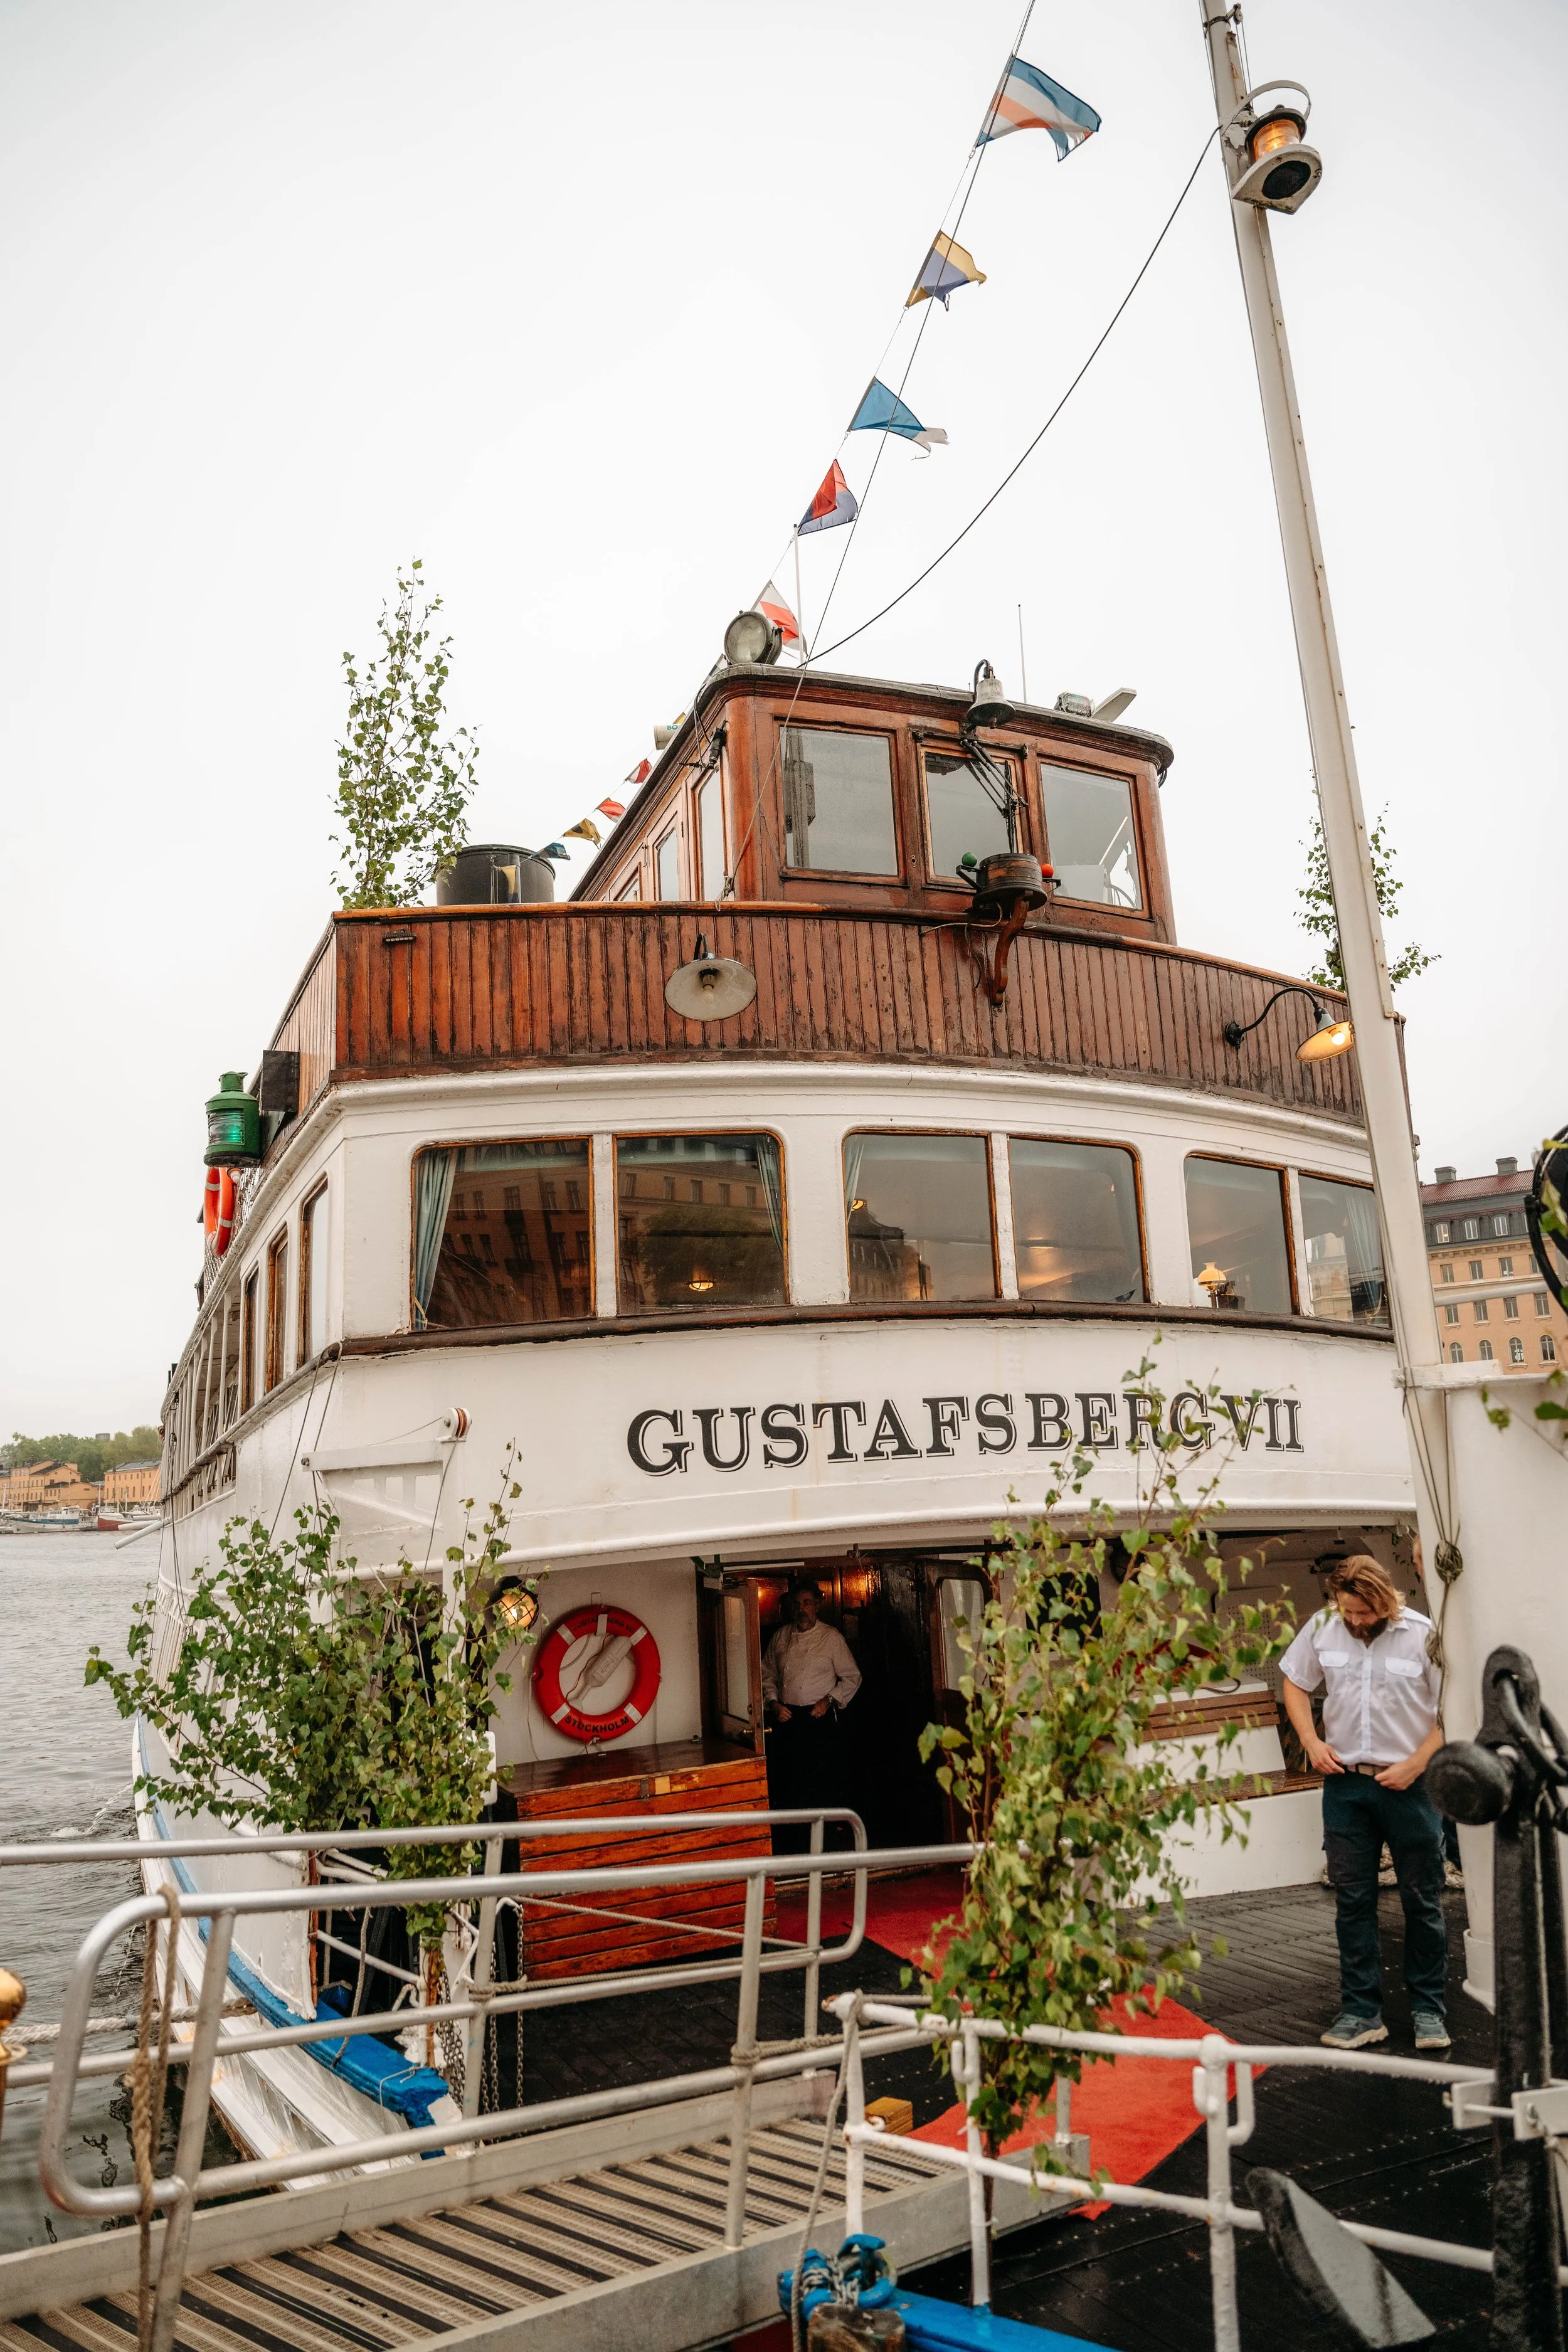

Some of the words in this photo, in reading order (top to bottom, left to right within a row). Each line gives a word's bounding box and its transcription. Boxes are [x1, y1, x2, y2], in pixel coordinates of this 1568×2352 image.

[627, 1392, 1216, 1476] GUSTAFSBERG
[1220, 1394, 1304, 1453] VII
[565, 1716, 630, 1733] STOCKHOLM
